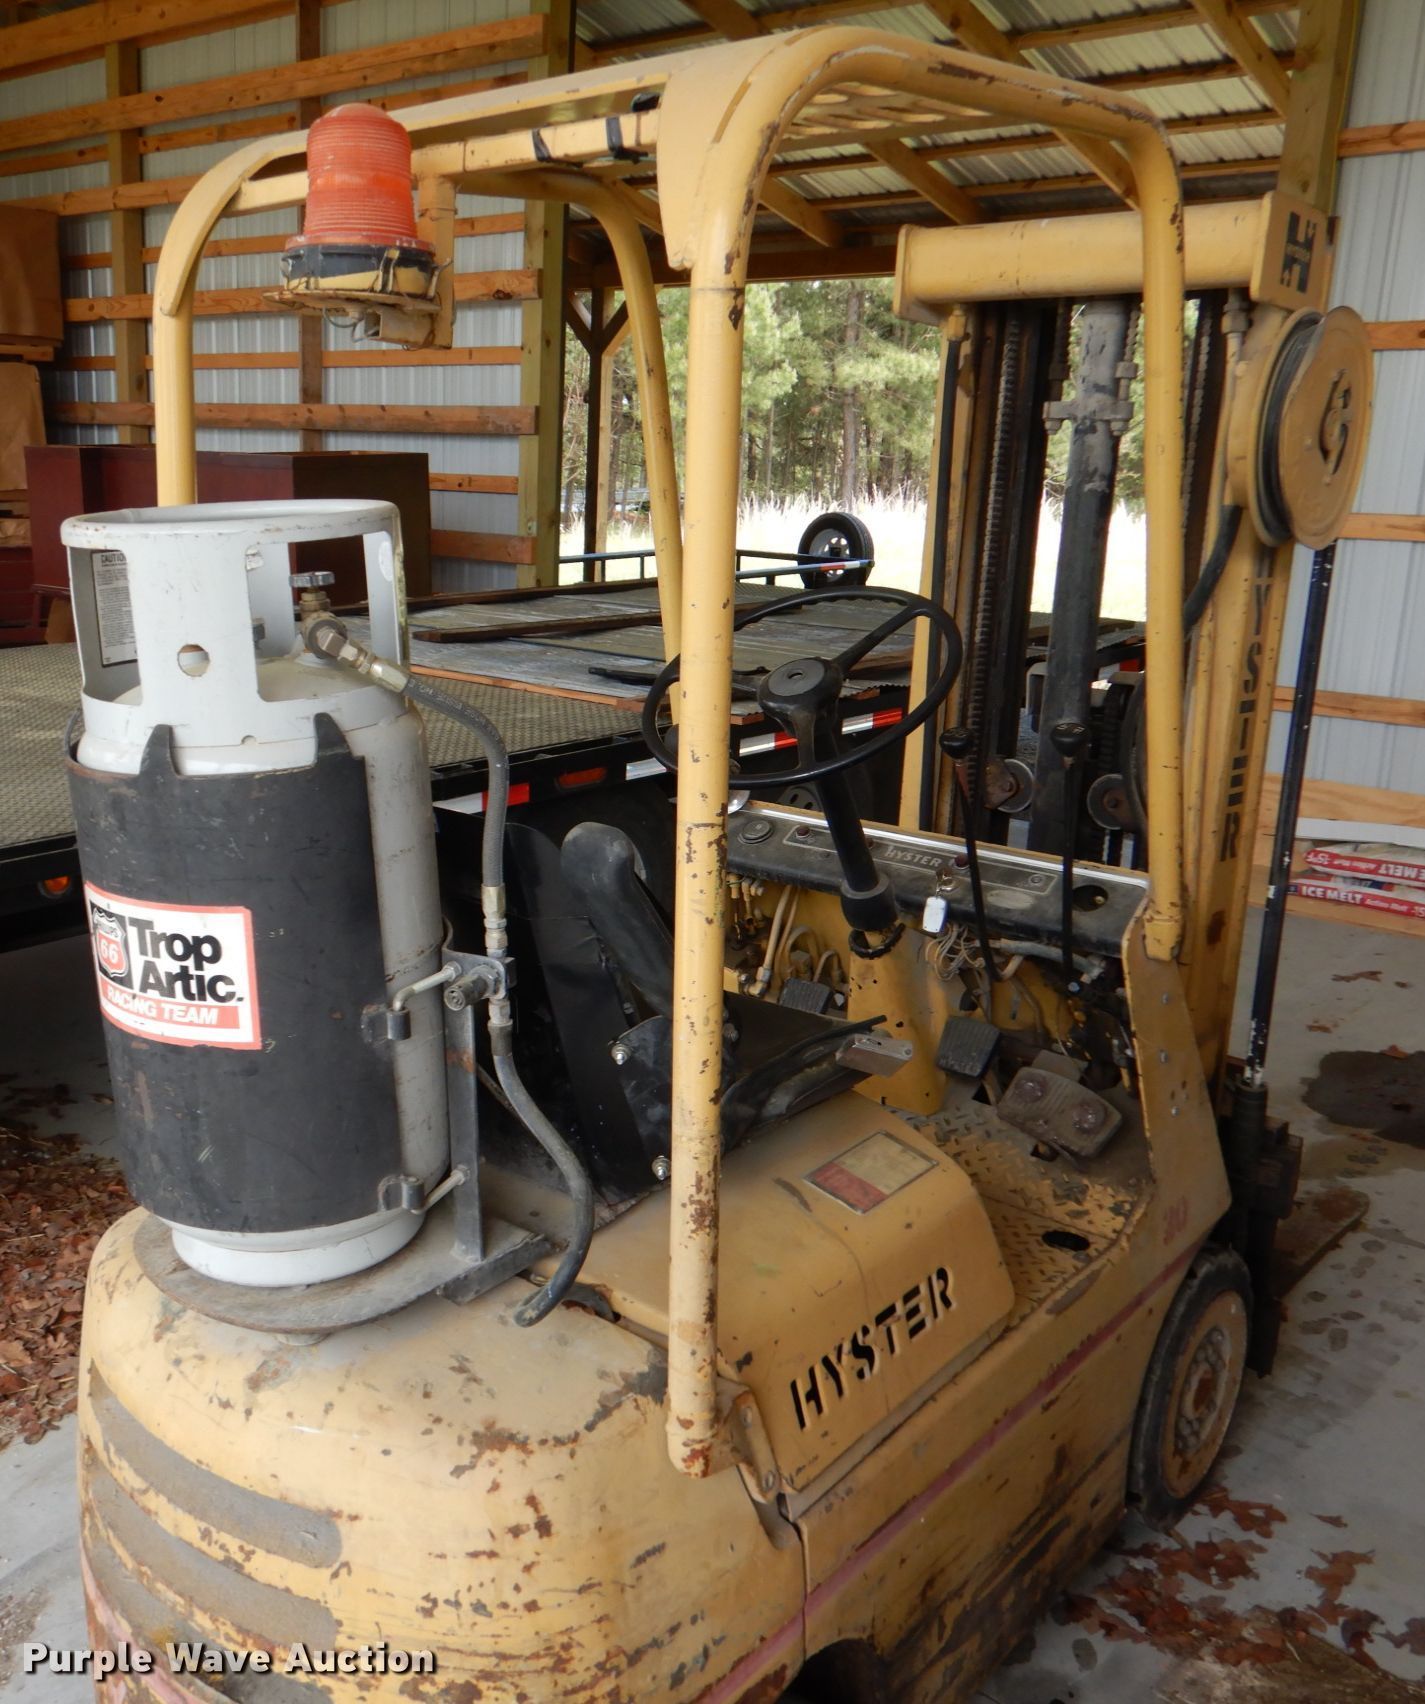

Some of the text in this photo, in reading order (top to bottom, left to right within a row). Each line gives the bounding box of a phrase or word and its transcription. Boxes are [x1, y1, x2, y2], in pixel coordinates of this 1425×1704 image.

[884, 844, 943, 868] HYSTER
[1377, 862, 1417, 879] MELT
[1302, 886, 1324, 898] ICE
[1326, 890, 1363, 905] MELT
[100, 939, 119, 964] 66
[128, 917, 223, 971] Trop
[139, 960, 245, 1003] Artic.
[107, 987, 219, 1026] RACING TEAM
[790, 1266, 956, 1430] HYSTER
